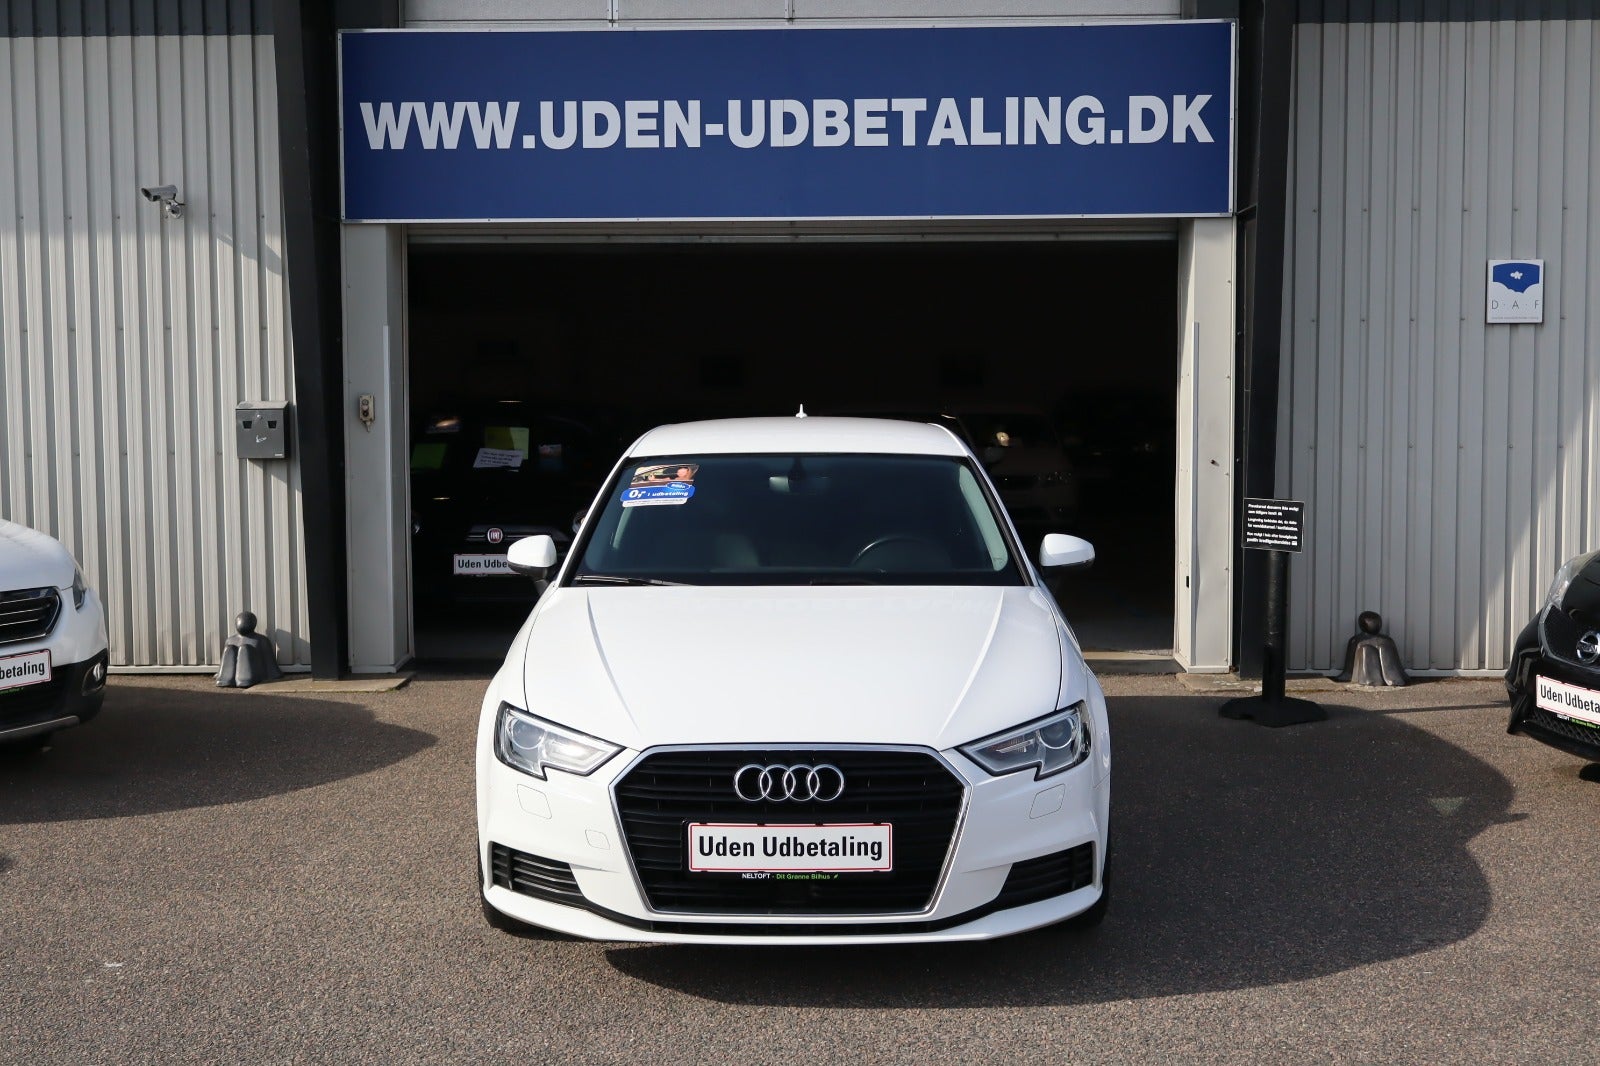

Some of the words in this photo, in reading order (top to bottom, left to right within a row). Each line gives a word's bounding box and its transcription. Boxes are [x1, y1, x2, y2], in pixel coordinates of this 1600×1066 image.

[360, 95, 1215, 149] WWW.UDEN-UDBETALING.DK
[458, 560, 481, 568] Uden
[1541, 684, 1563, 703] Uden
[699, 836, 755, 857] Uden
[763, 836, 882, 861] Udbetaling
